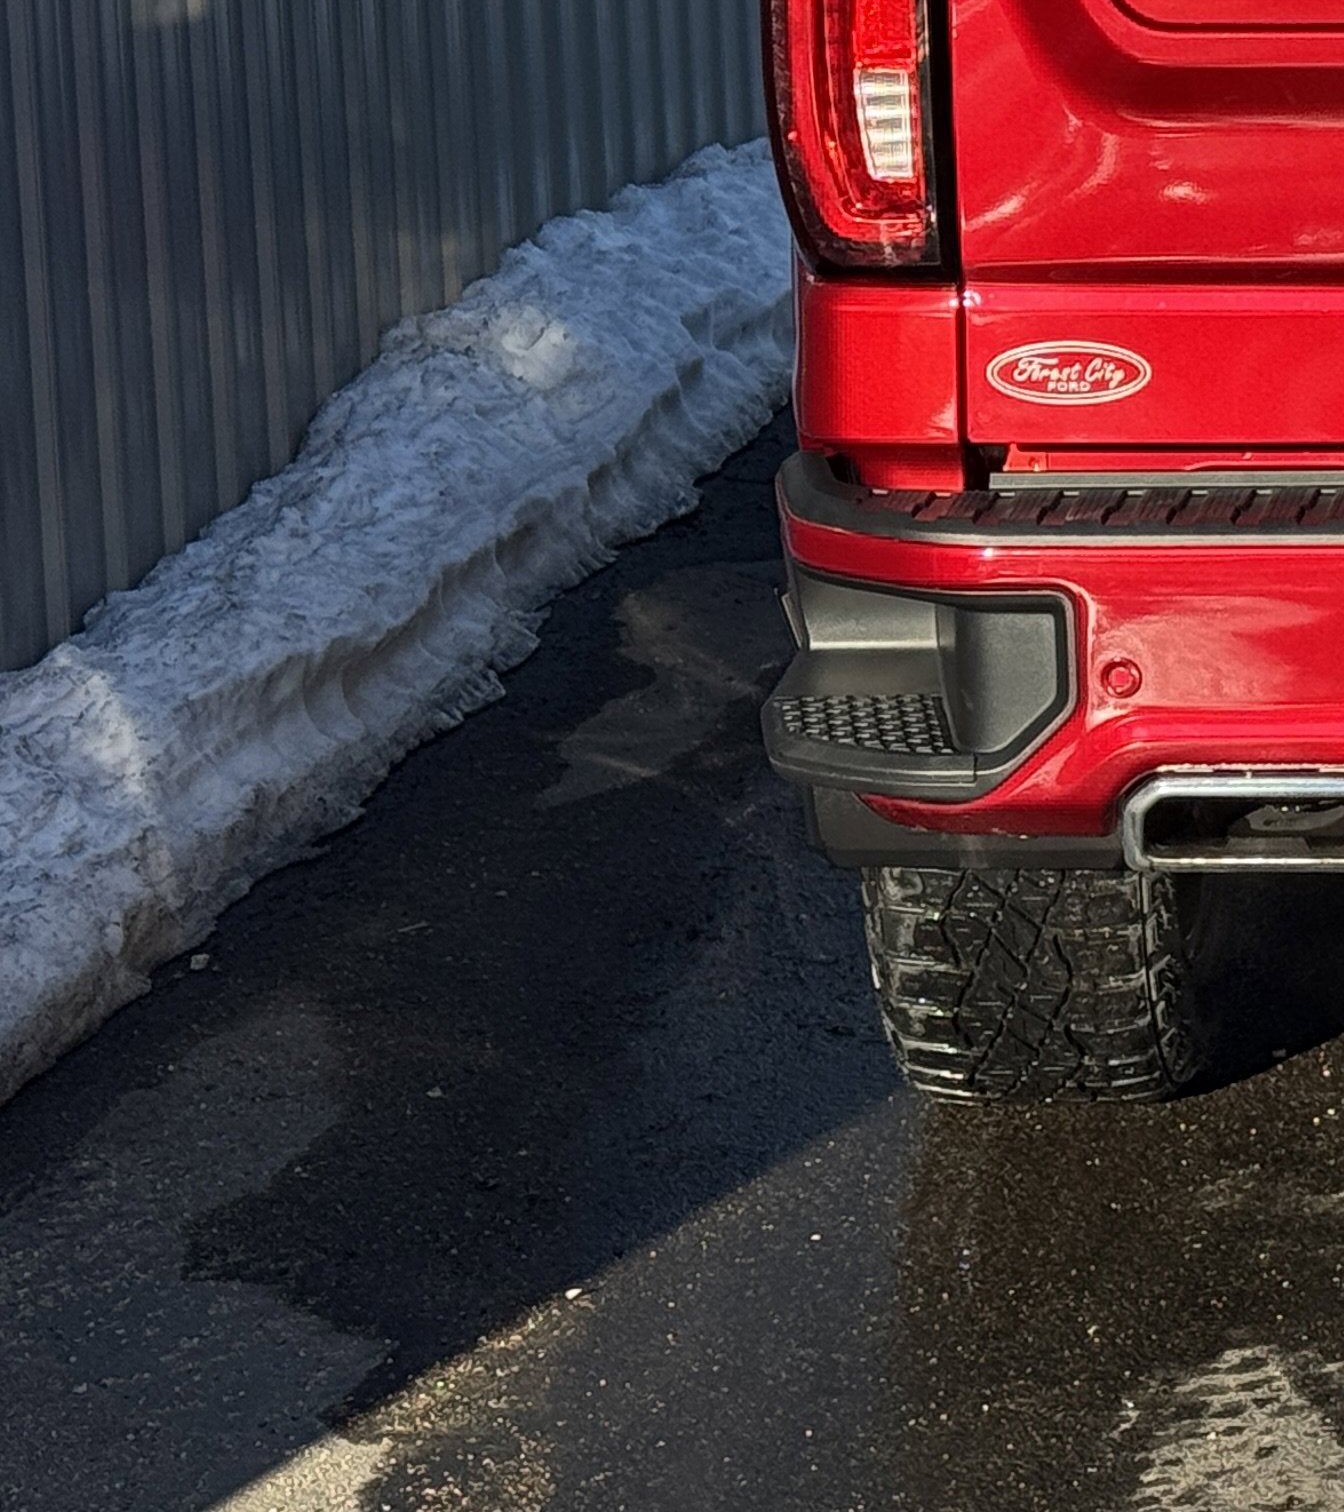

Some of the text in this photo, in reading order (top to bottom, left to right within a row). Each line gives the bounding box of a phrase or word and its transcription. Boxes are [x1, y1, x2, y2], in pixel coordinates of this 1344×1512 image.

[1013, 356, 1127, 389] Forest City
[1046, 380, 1091, 392] FORD
